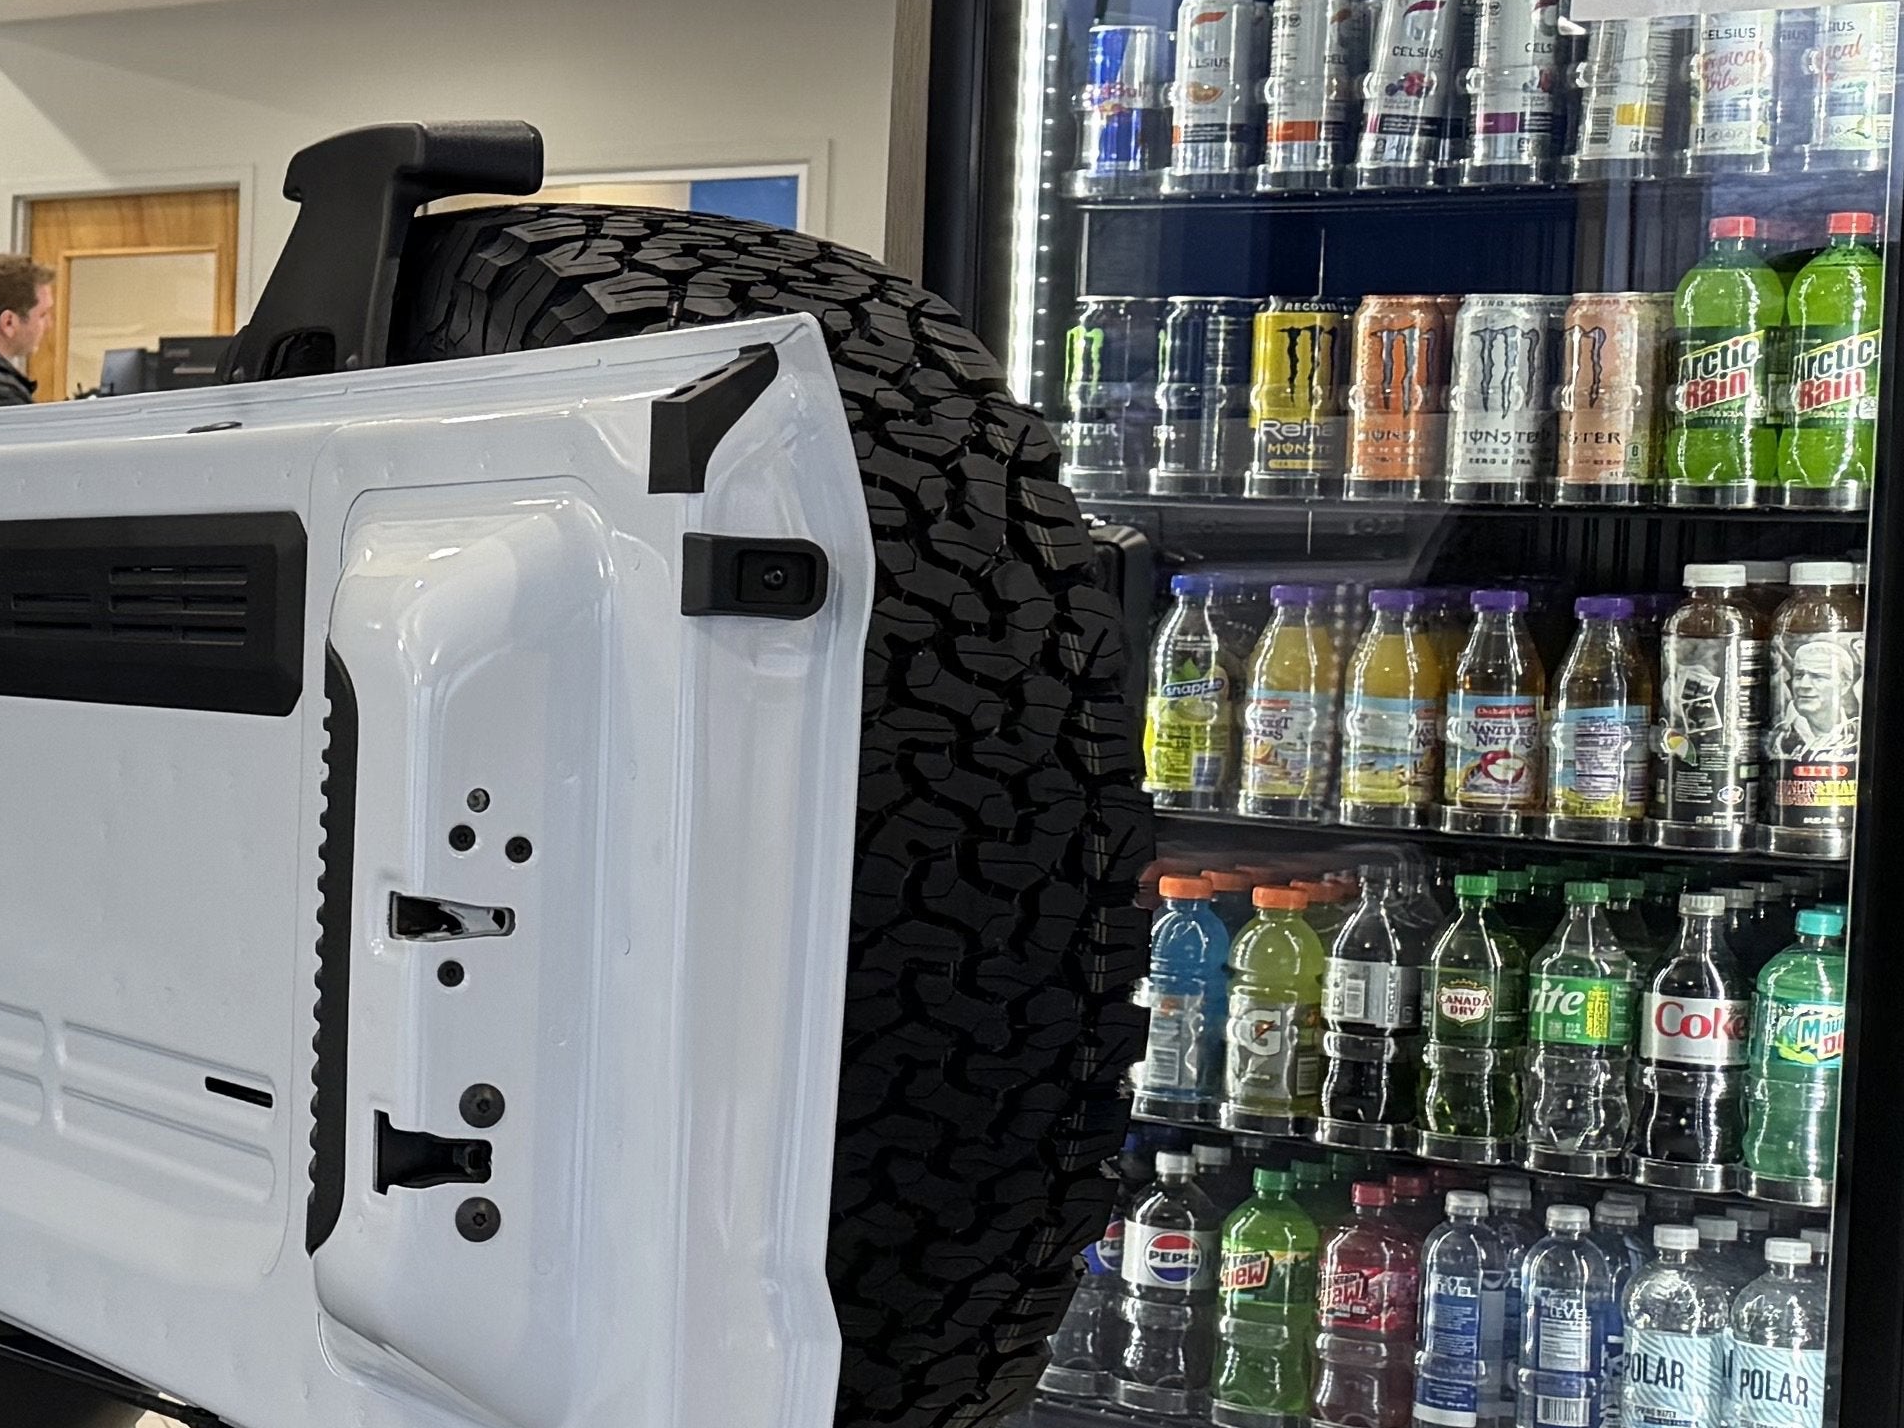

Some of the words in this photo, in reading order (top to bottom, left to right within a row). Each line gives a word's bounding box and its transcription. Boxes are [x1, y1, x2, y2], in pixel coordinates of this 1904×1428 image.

[1392, 46, 1445, 60] CELSIUS
[1685, 370, 1749, 411] Rain
[1798, 370, 1865, 411] Rain
[1165, 679, 1224, 698] snapple
[1440, 993, 1491, 1008] CANADA
[1449, 1003, 1477, 1017] DRY
[1655, 1001, 1749, 1041] Coke
[1149, 1249, 1199, 1265] PEPSI
[1623, 1352, 1684, 1392] POLAR
[1740, 1367, 1809, 1409] POLAR
